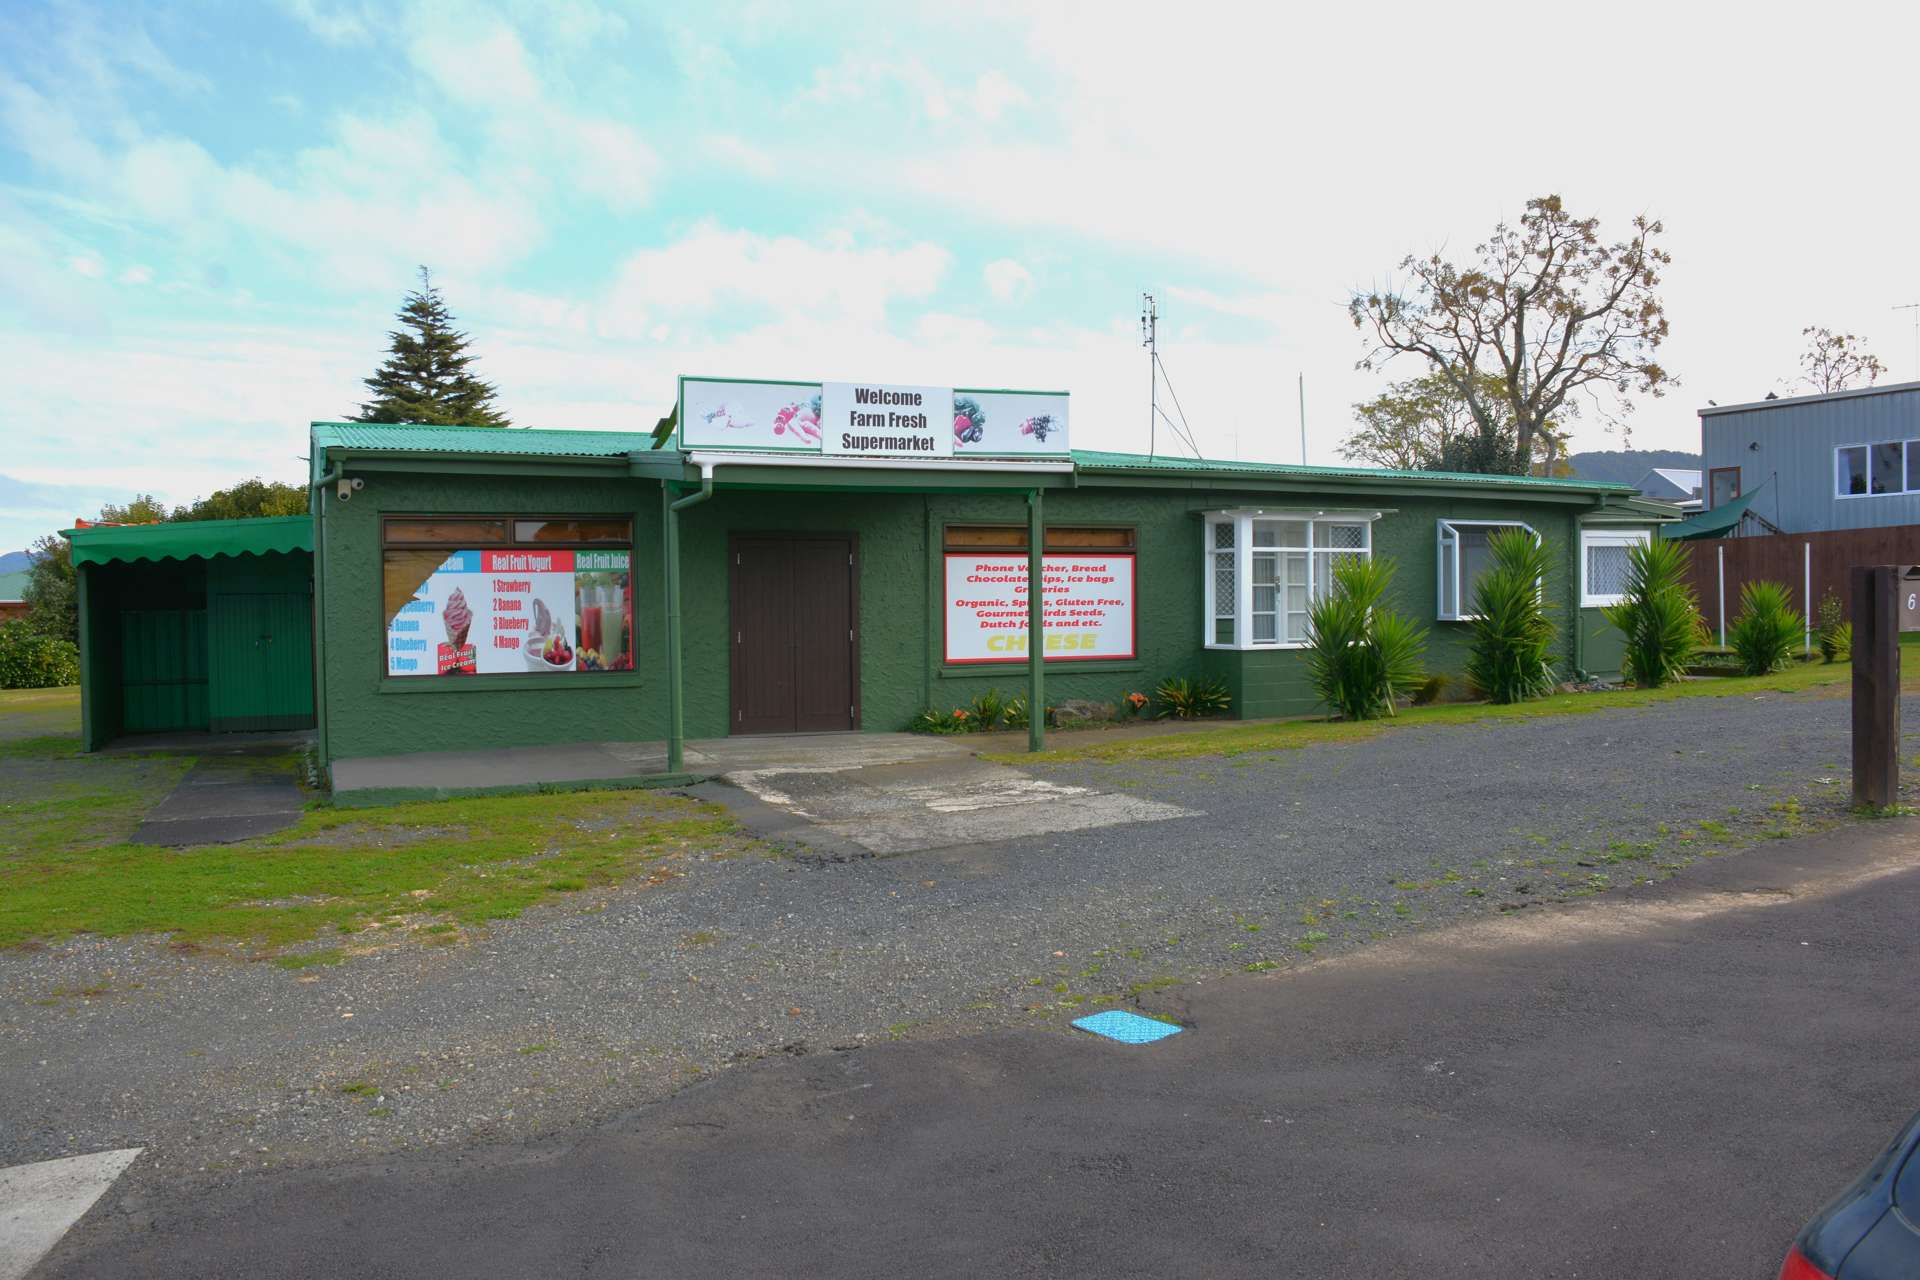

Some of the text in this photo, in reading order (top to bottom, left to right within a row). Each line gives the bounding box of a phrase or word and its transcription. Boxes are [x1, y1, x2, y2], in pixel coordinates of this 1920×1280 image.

[855, 388, 922, 406] Welcome
[850, 411, 927, 428] Farm Fresh
[842, 433, 935, 451] Supermarket
[492, 555, 552, 571] Real Fruit Yogurt
[576, 553, 630, 568] Real Fruit Juice
[975, 564, 1014, 572] Phone
[1072, 564, 1107, 572] Bread
[966, 575, 1029, 583] Chocolate
[1086, 575, 1114, 584] bags
[493, 580, 531, 593] 1 Strawberry
[493, 599, 522, 611] 2 Banana
[956, 599, 1009, 608] Organic,
[1055, 598, 1095, 606] Gluten
[1097, 599, 1125, 607] Free,
[1907, 593, 1917, 610] 6
[1043, 609, 1067, 617] irds
[1069, 609, 1105, 618] Seeds,
[396, 619, 419, 632] Banana
[493, 617, 529, 630] 3 Blueberry
[980, 620, 1016, 628] Dutch
[391, 638, 427, 652] 4 Blueberry
[494, 636, 520, 649] 4 Mango
[986, 633, 1099, 651] CHESE
[440, 649, 473, 662] Real Fruit
[391, 657, 417, 671] 5 Mango
[441, 659, 476, 671] Ice Cream
